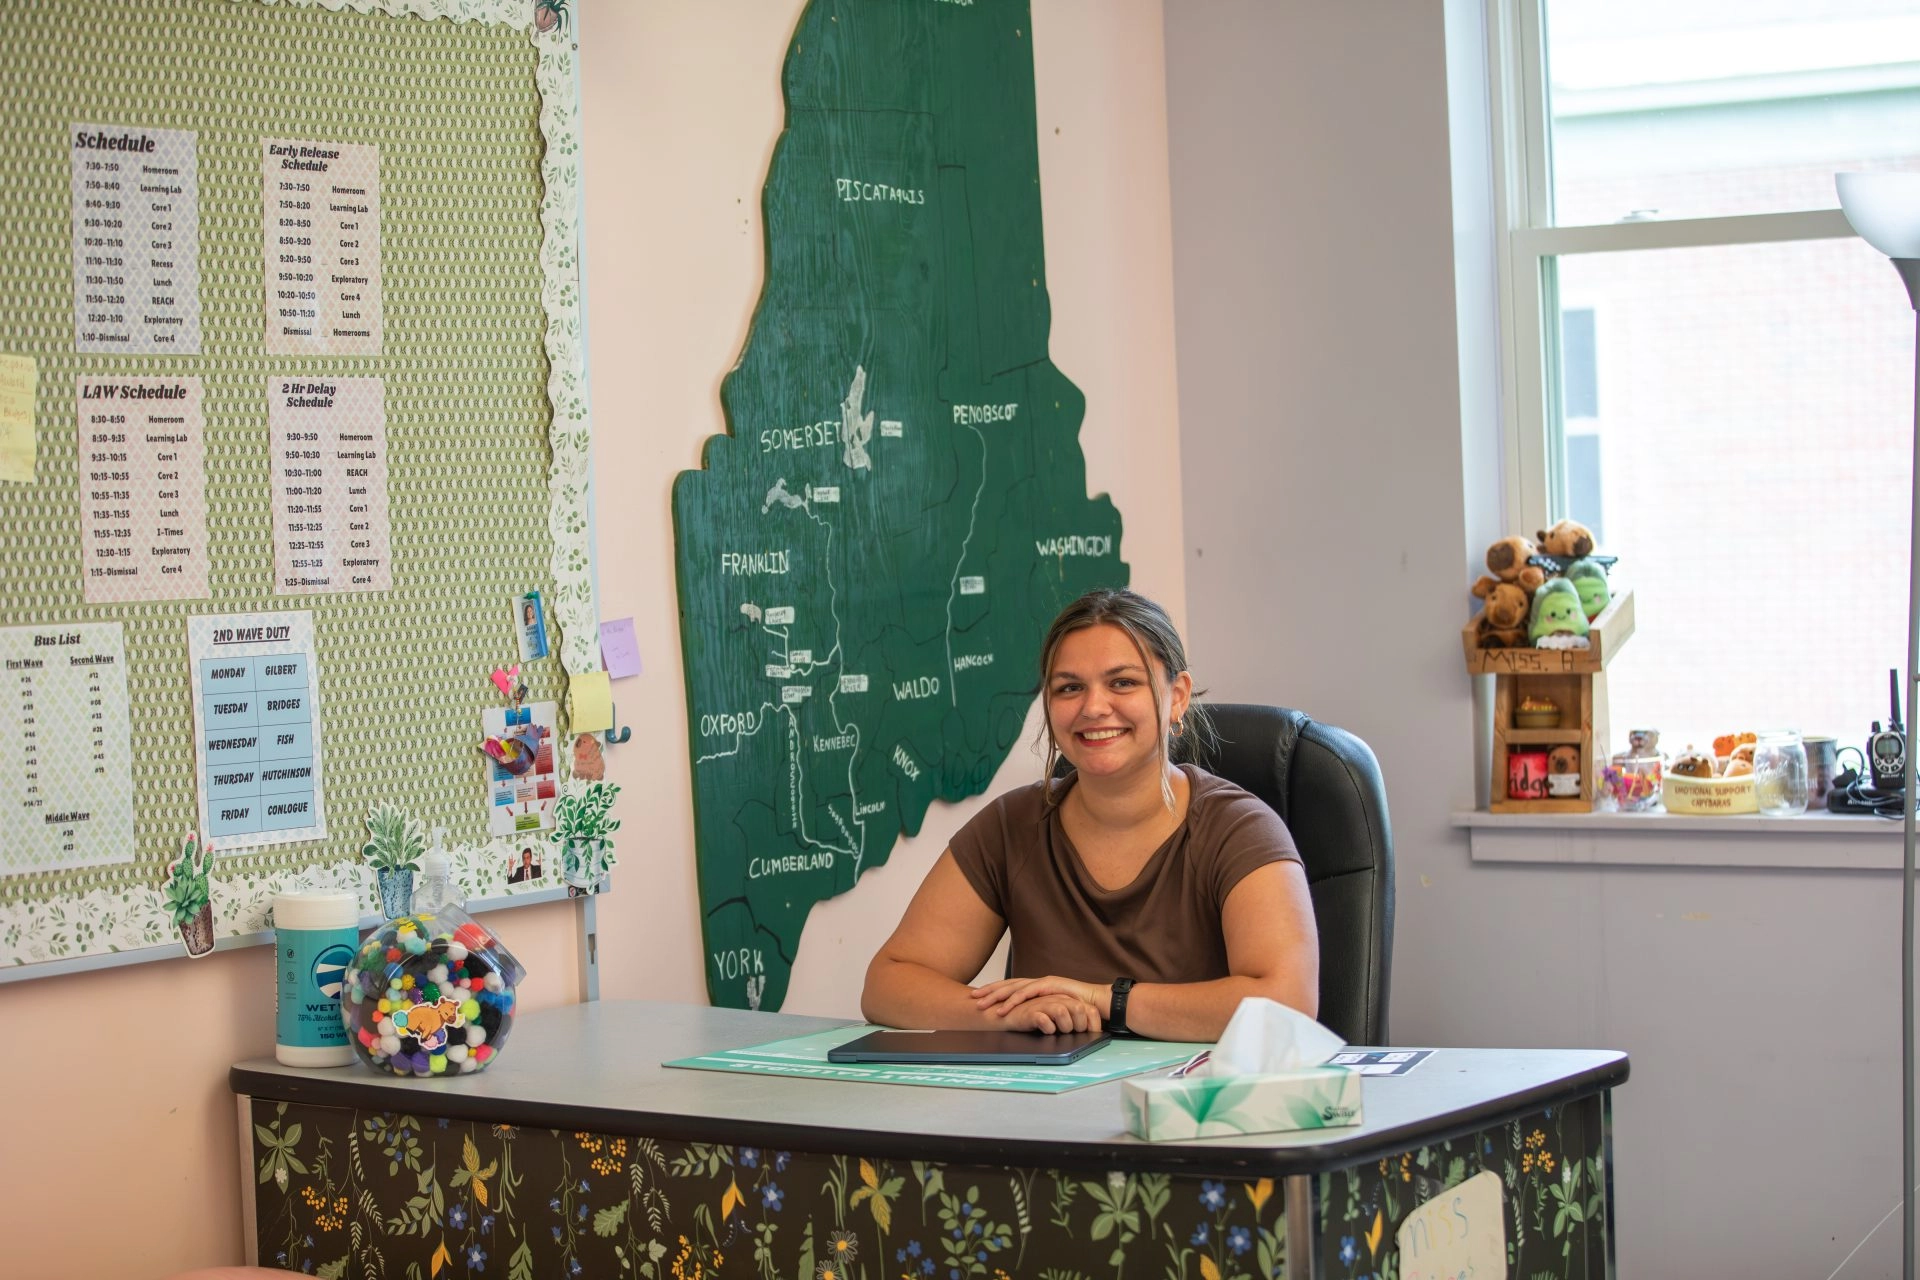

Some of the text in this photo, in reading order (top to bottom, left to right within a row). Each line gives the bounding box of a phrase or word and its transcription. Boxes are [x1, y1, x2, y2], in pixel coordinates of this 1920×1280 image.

[75, 132, 156, 153] Schedule
[269, 144, 340, 159] Early Release
[142, 166, 179, 175] Homeroom
[281, 159, 328, 171] Schedule
[140, 184, 182, 194] Learning Lab
[332, 186, 365, 195] Homeroom
[152, 203, 167, 212] Core
[330, 204, 356, 214] Learning
[152, 222, 167, 231] Core
[152, 241, 167, 249] Core
[151, 260, 173, 268] Recess
[153, 278, 172, 287] Lunch
[331, 275, 368, 285] Exploratory
[152, 296, 174, 305] REACH
[144, 316, 183, 325] Exploratory
[342, 311, 360, 319] Lunch
[283, 327, 312, 336] Dismissal
[333, 329, 370, 337] Homerooms
[154, 334, 175, 343] Core 4
[83, 385, 187, 399] LAW Schedule
[282, 384, 336, 396] 2 Hr Delay
[286, 397, 333, 408] Schedule
[953, 404, 1018, 425] PENOBSCOT
[146, 435, 175, 444] Learning
[761, 421, 841, 452] SOMERSET
[337, 451, 364, 460] Learning
[152, 547, 190, 556] Exploratory
[1036, 535, 1112, 557] WASHINGTON
[343, 558, 379, 567] Exploratory
[721, 550, 790, 574] FRANKLIN
[34, 633, 81, 646] Bus List
[213, 626, 290, 642] 2ND WAVE DUTY
[6, 659, 43, 668] First Wave
[70, 655, 114, 665] Second Wave
[954, 654, 994, 671] HANCOCK
[211, 668, 245, 679] MONDAY
[265, 664, 297, 675] GILBERT
[893, 677, 940, 701] WALDO
[214, 703, 247, 714] TUESDAY
[267, 699, 300, 710] BRIDGES
[701, 712, 754, 737] OXFORD
[209, 737, 257, 750] WEDNESDAY
[277, 735, 294, 745] FISH
[813, 735, 856, 752] KENNEBEC
[892, 744, 920, 781] KNOX
[214, 773, 254, 785] THURSDAY
[262, 767, 311, 780] HUTCHINSON
[1675, 785, 1751, 795] EMOTIONAL SUPPORT
[1692, 798, 1731, 807] CAPYBARAS
[221, 808, 249, 820] FRIDAY
[268, 802, 308, 815] CONLOGUE
[46, 812, 90, 822] Middle Wave
[749, 853, 833, 878] CUMBERLAND
[714, 948, 764, 980] YORK
